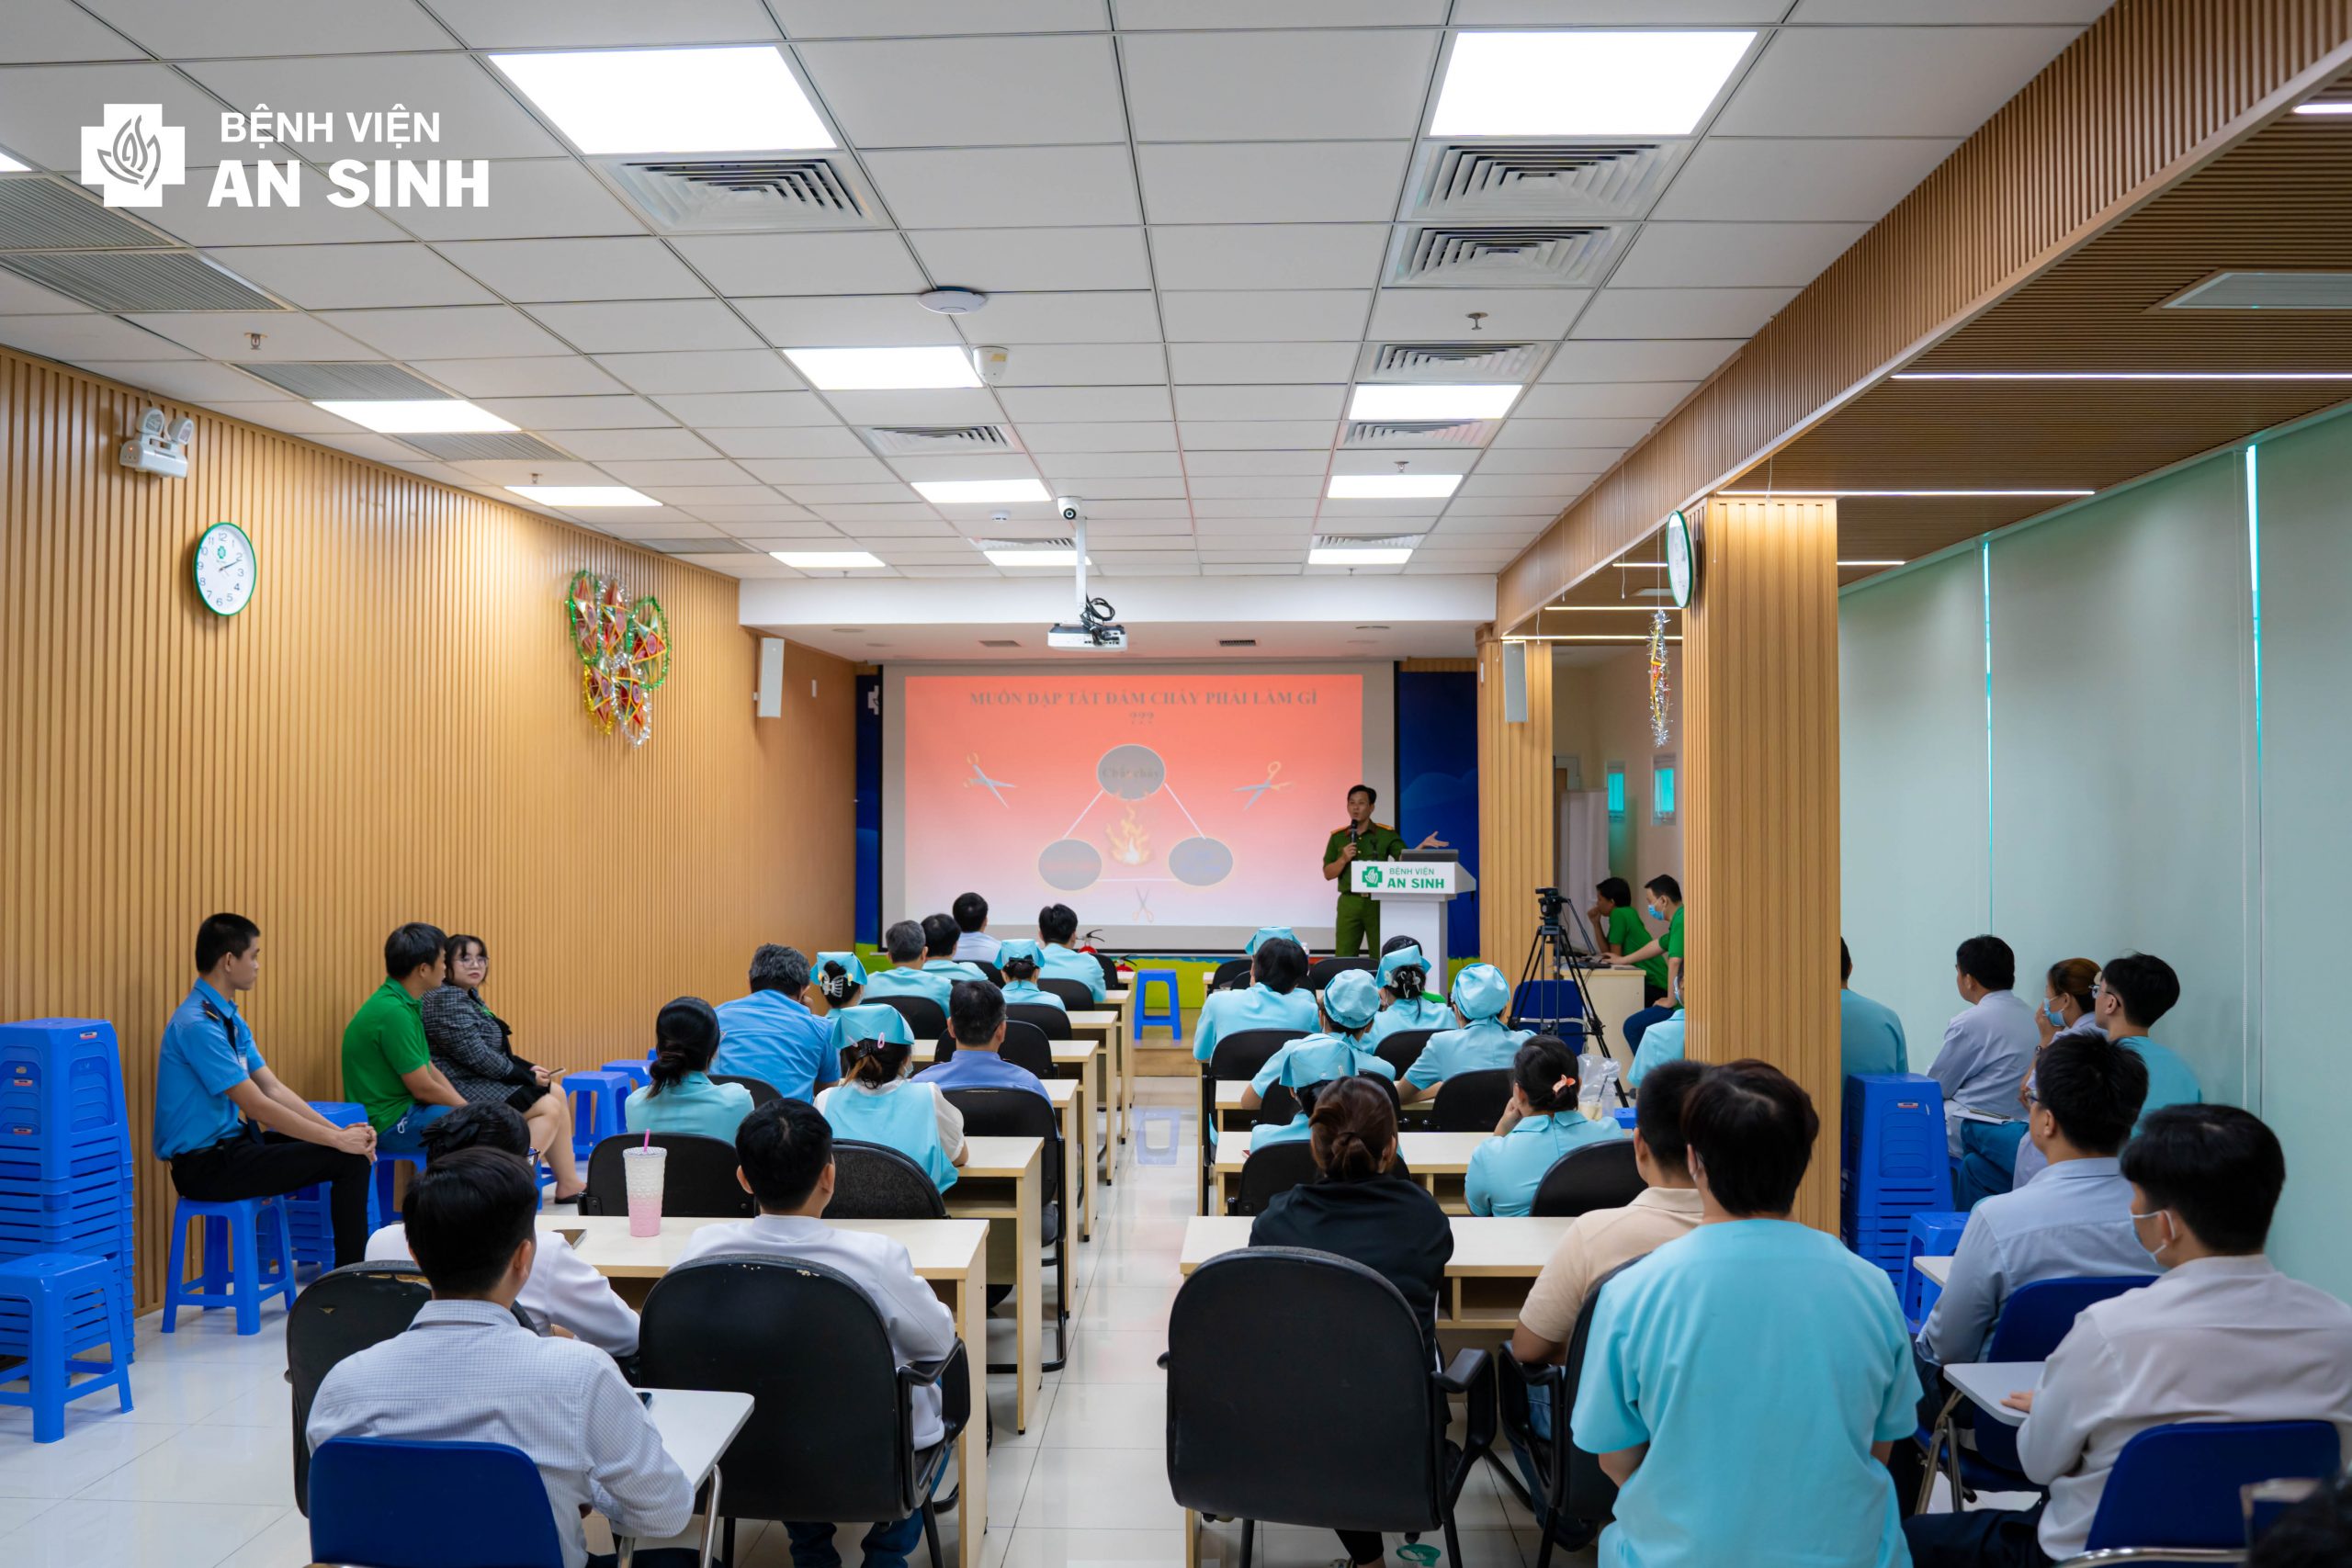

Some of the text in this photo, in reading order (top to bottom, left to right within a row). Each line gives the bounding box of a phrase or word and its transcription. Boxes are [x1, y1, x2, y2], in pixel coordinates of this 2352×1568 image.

[1389, 866, 1435, 876] BỆNH VIỆN
[1387, 877, 1444, 888] AN SINH
